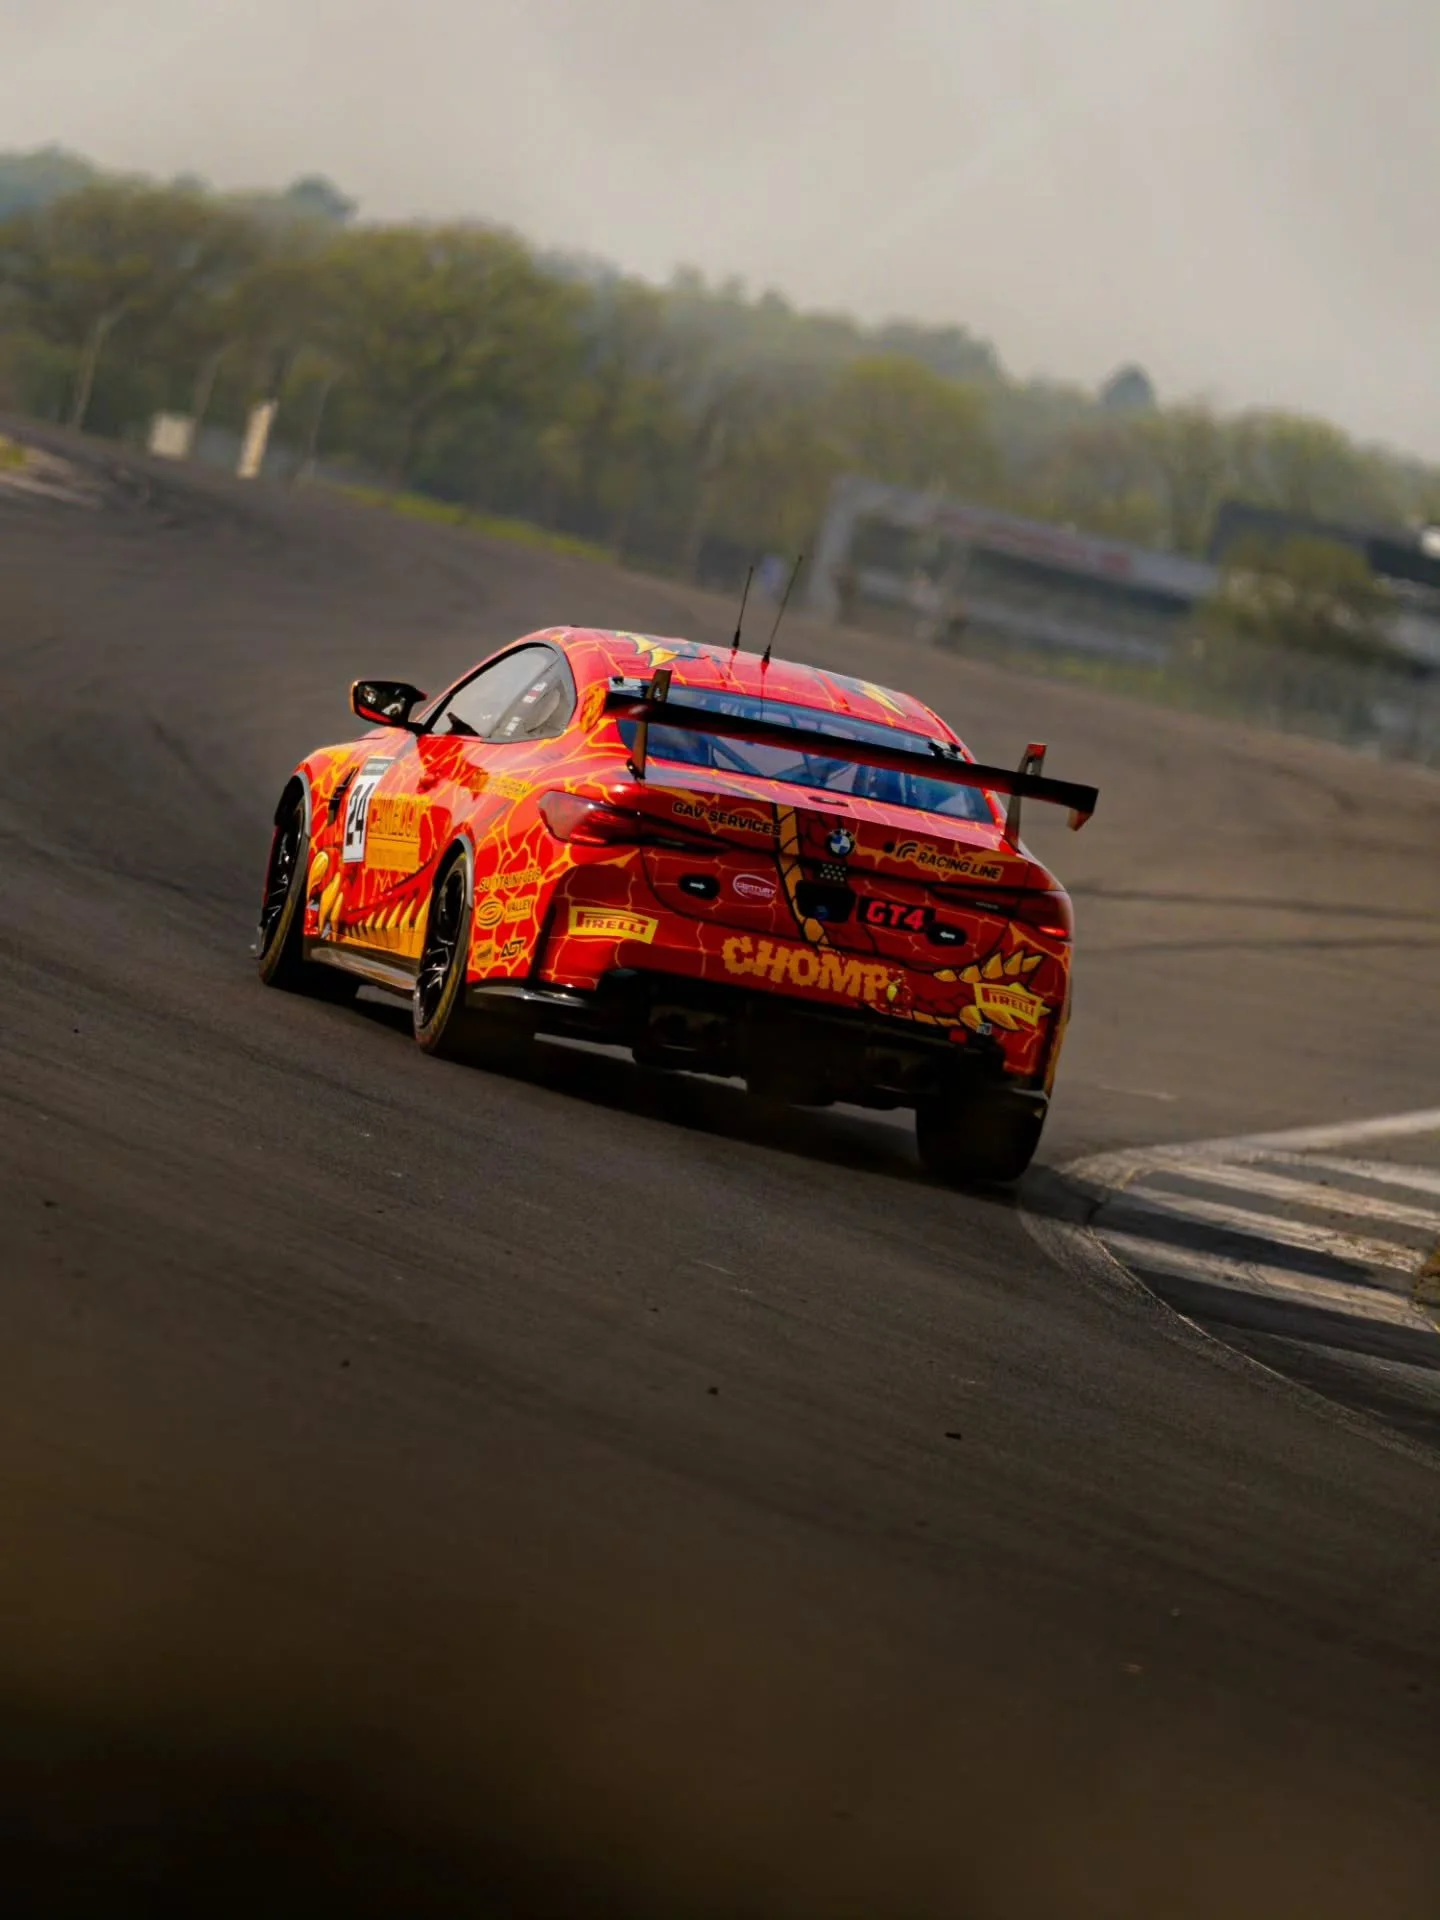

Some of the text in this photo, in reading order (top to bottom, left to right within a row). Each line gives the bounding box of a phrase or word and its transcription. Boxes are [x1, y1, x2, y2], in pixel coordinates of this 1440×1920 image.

[345, 783, 375, 847] 24
[673, 802, 782, 835] GAV SERVICES
[917, 851, 1001, 879] RACING LINE
[576, 911, 649, 935] PIRELLI
[866, 901, 925, 930] GT4
[722, 936, 889, 1001] CHOMP
[982, 987, 1037, 1017] PIRELLI
